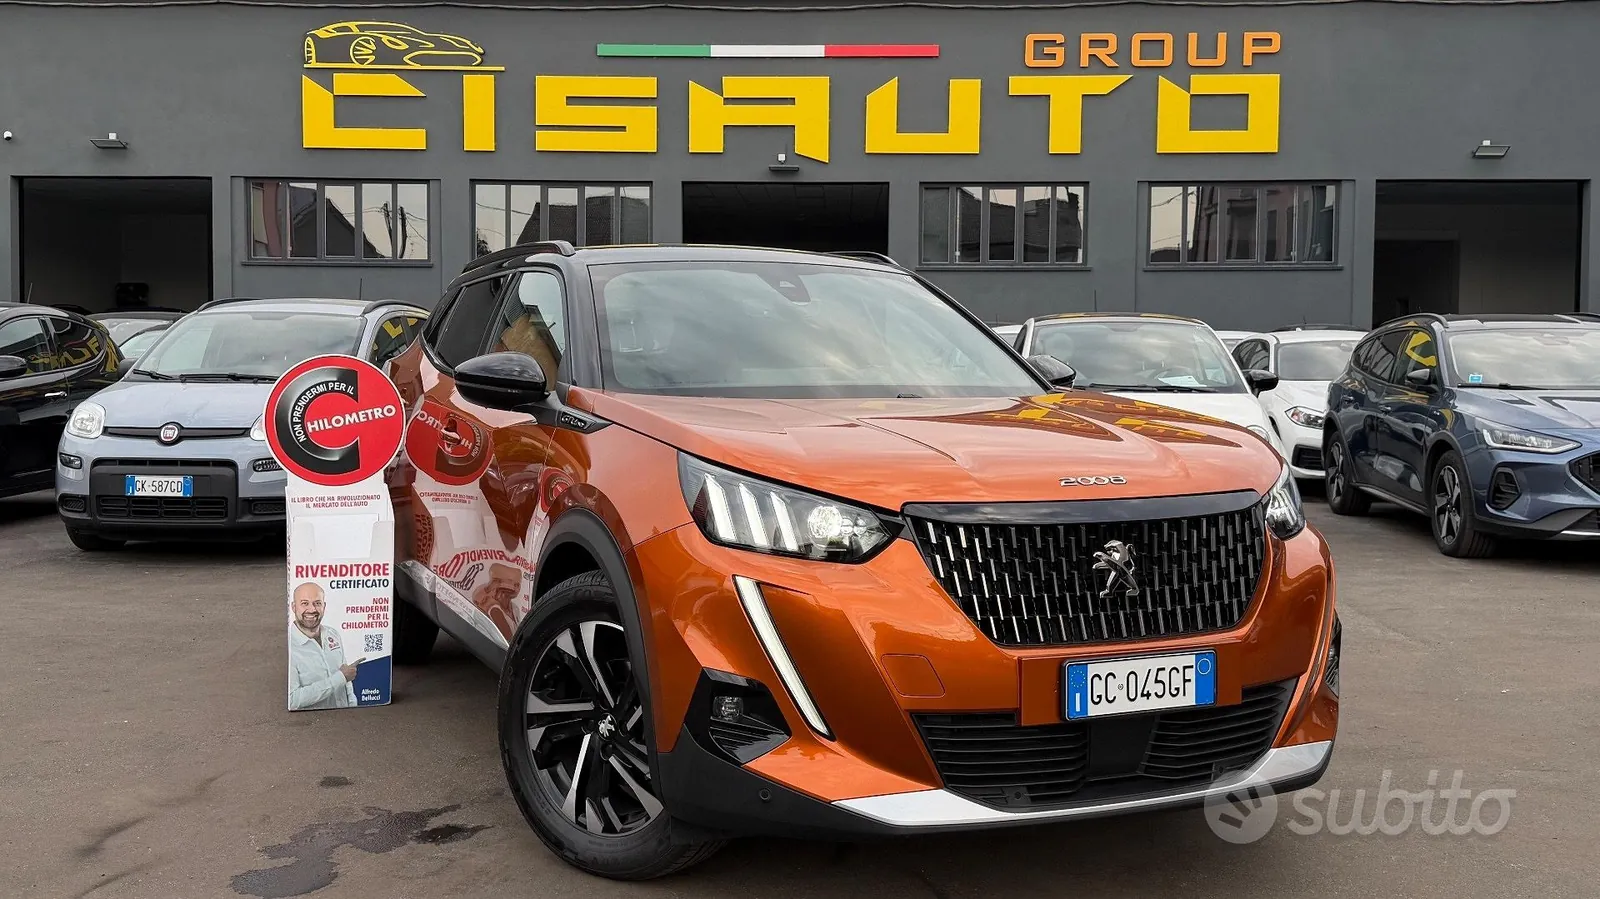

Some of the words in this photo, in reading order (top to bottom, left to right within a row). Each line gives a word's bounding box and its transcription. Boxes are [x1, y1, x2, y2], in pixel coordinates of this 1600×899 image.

[1024, 32, 1282, 69] GROUP
[301, 72, 1281, 164] CISAUTO
[328, 382, 346, 392] PER
[346, 385, 355, 395] IL
[293, 383, 327, 422] PRENDERMI
[293, 422, 307, 442] NON
[1059, 475, 1128, 487] 2008
[337, 494, 381, 502] RIVOLUZIONATO
[295, 563, 390, 578] RIVENDITORE
[329, 578, 390, 589] CERTIFICATO
[372, 597, 389, 605] NON
[345, 605, 389, 613] PRENDERMI
[367, 613, 381, 621] PER
[341, 621, 389, 630] CHILOMETRO
